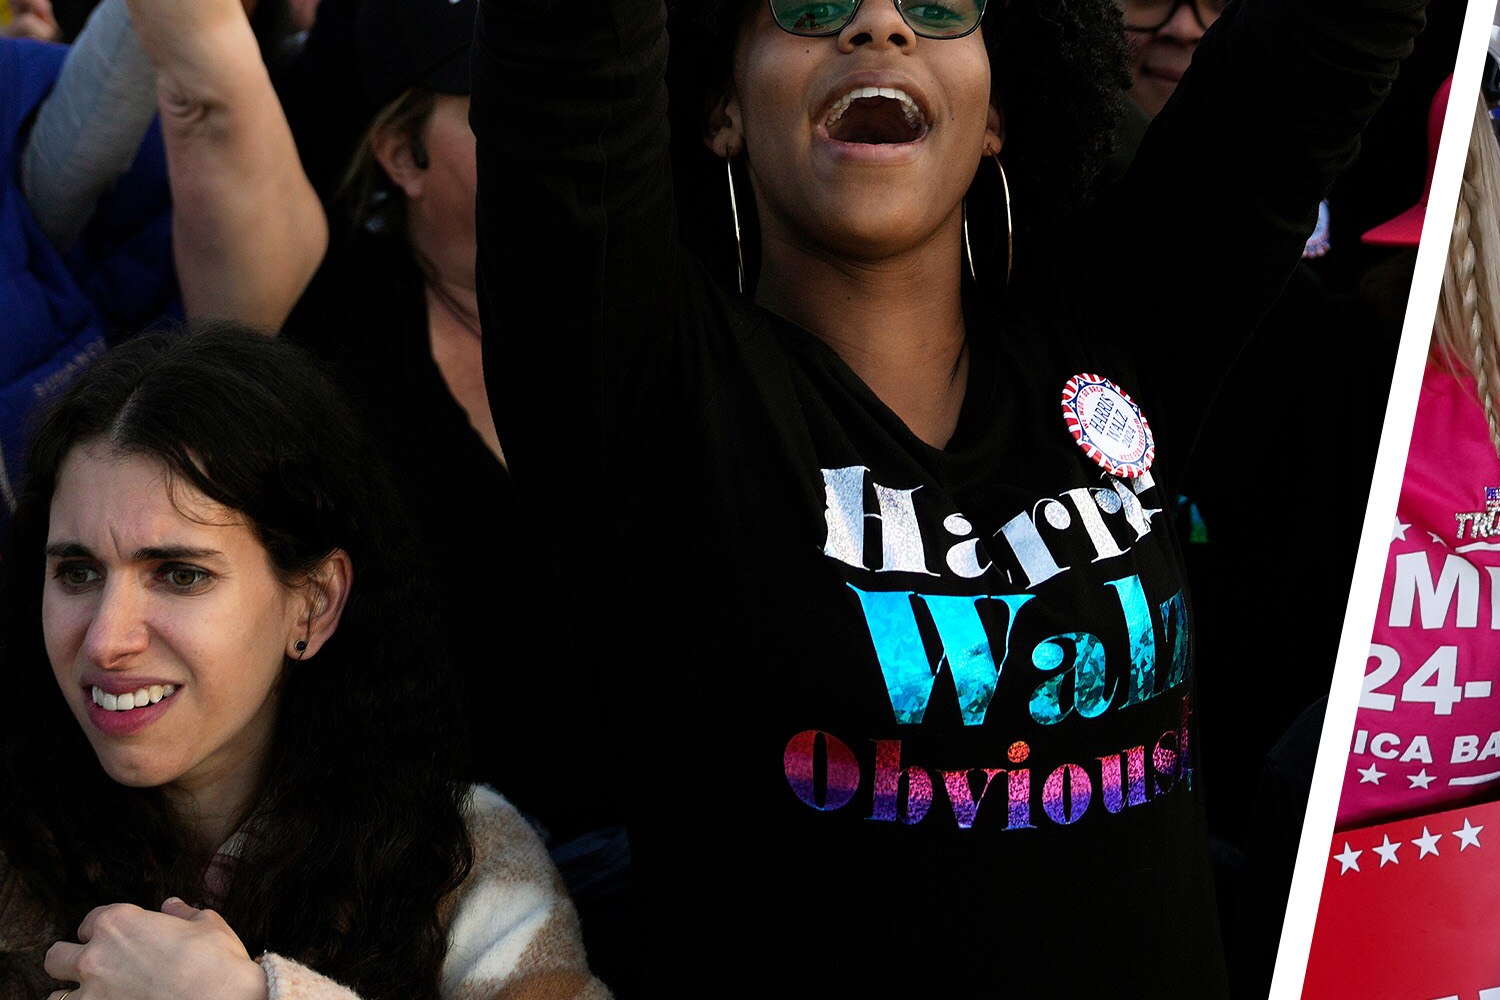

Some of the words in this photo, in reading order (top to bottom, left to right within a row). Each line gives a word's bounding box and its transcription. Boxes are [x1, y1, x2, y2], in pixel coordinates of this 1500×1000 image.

[1089, 393, 1114, 434] HARRIS
[1106, 408, 1128, 442] WALZ
[1122, 426, 1137, 448] 2024
